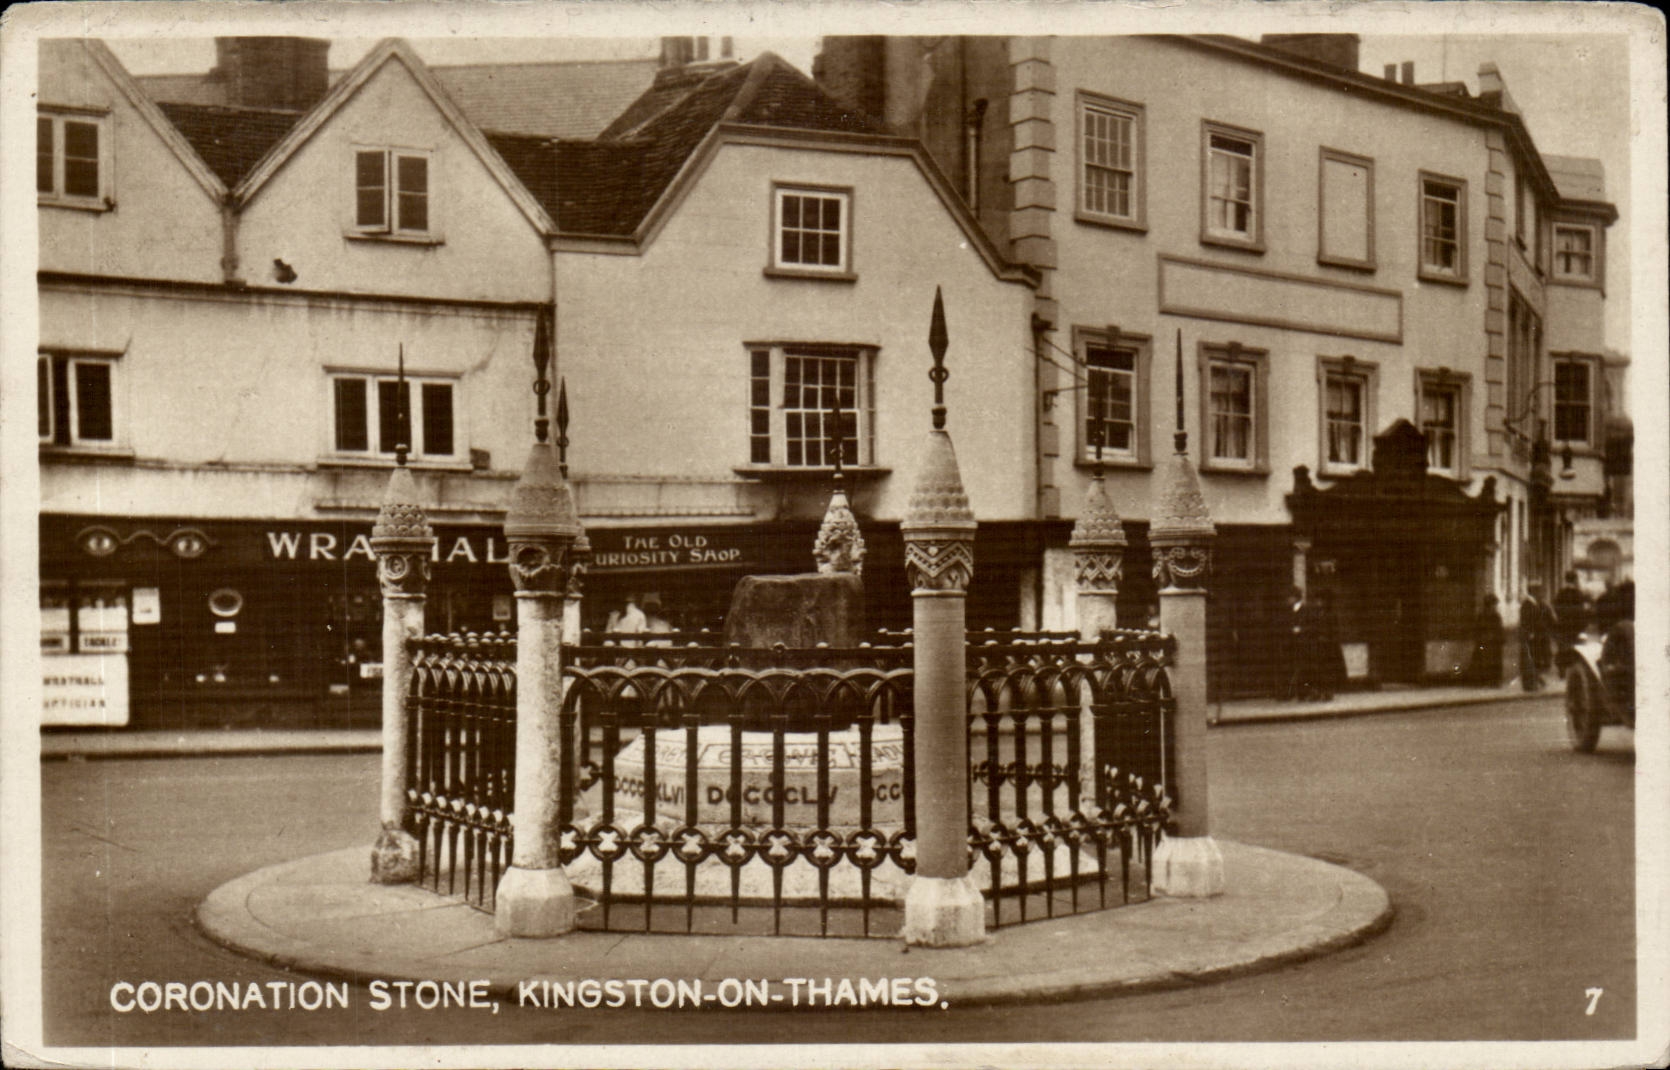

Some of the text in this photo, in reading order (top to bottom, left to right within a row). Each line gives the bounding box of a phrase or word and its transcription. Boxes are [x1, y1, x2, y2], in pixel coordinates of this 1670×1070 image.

[624, 533, 708, 550] THE OLD
[594, 549, 681, 566] URIOSITY
